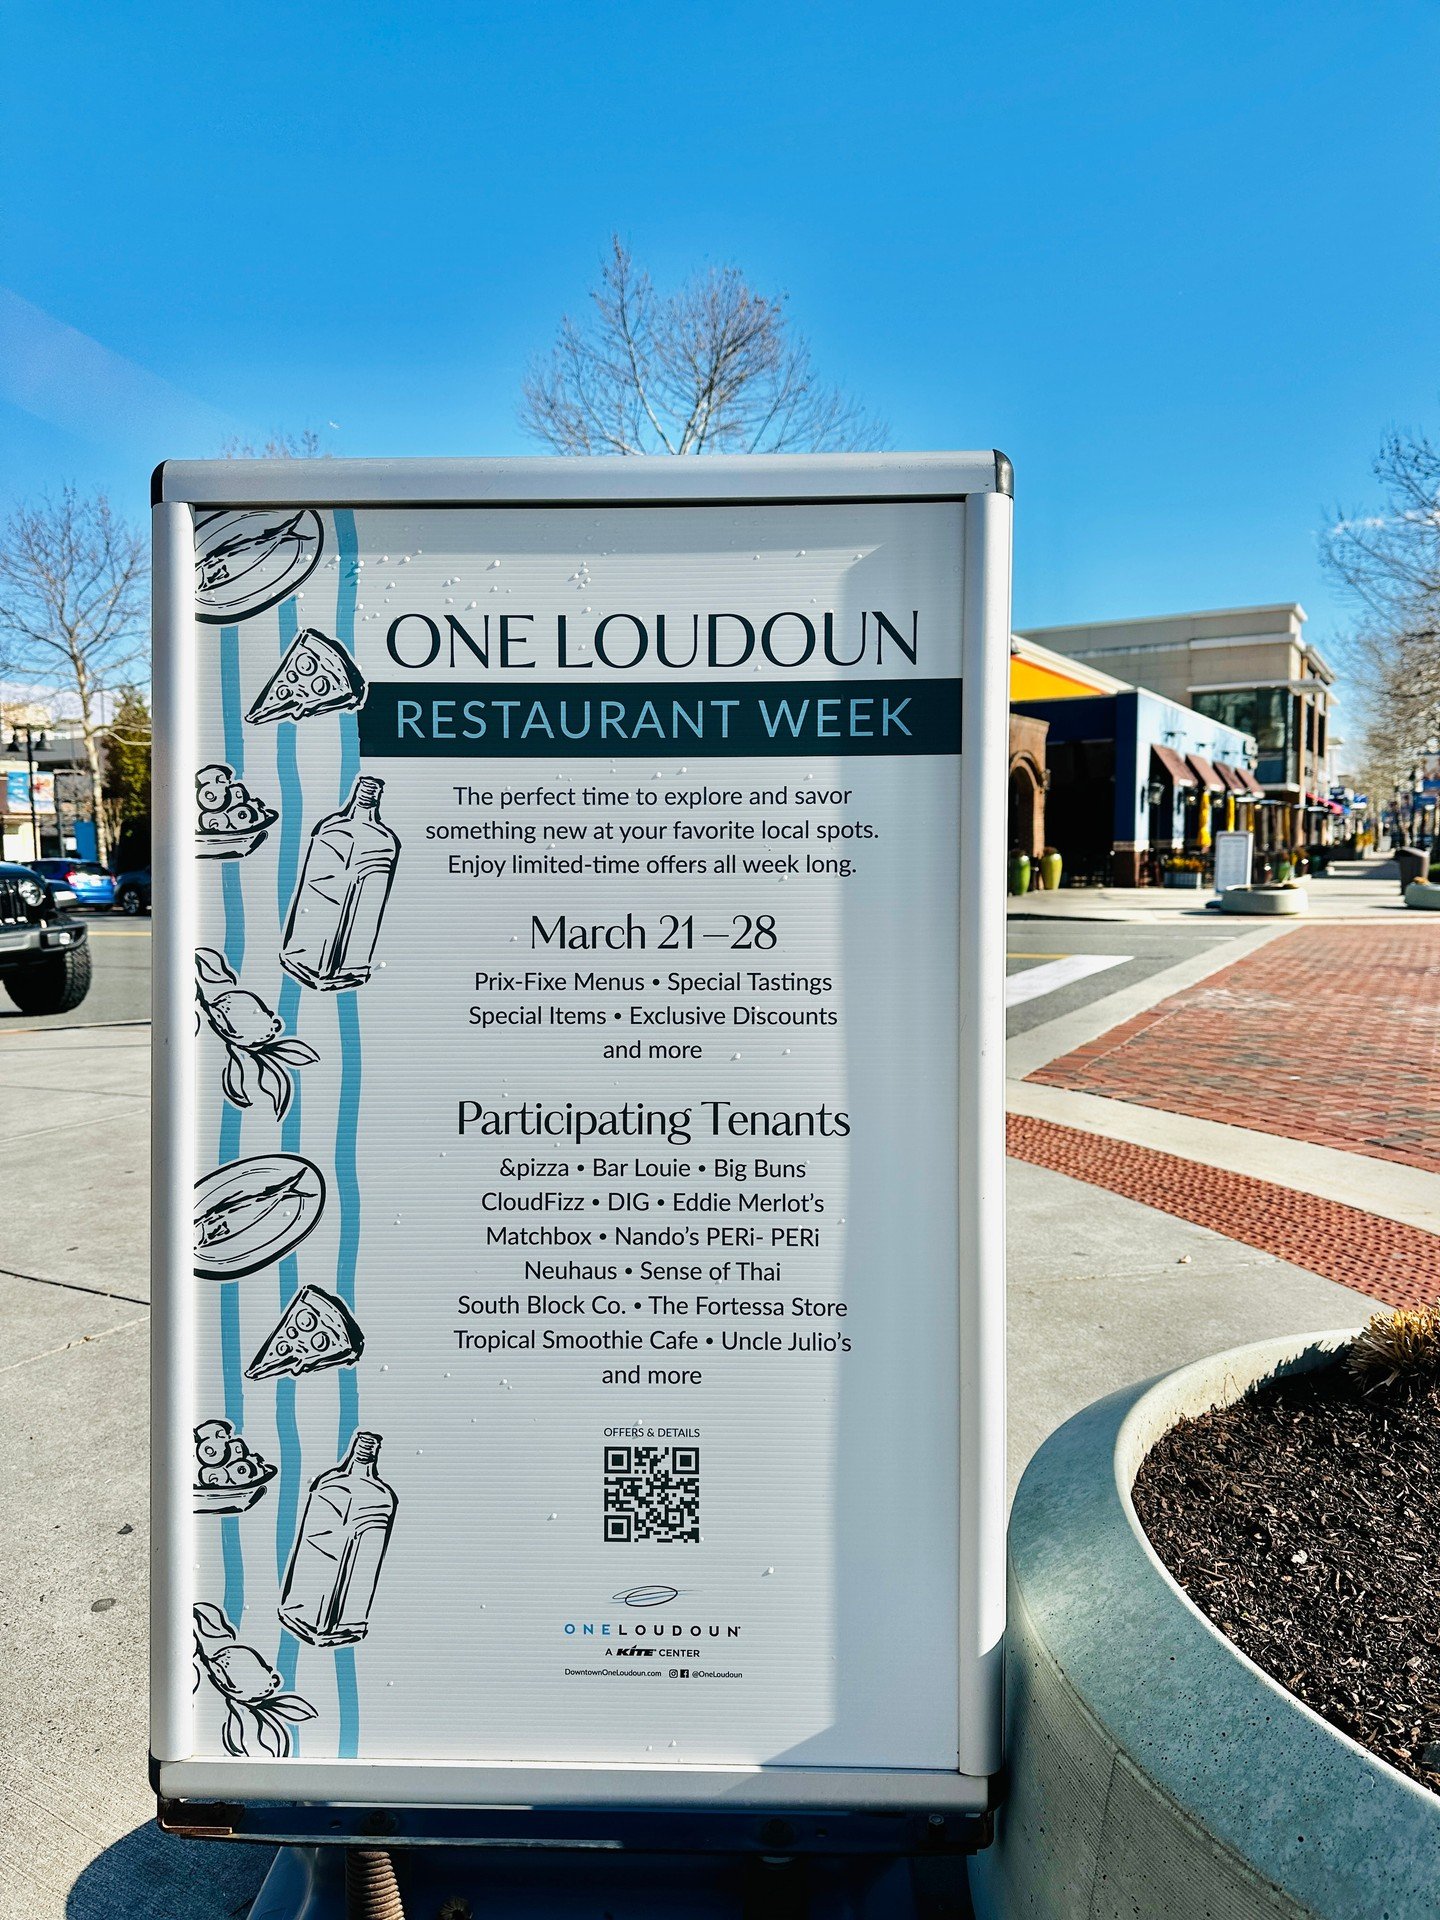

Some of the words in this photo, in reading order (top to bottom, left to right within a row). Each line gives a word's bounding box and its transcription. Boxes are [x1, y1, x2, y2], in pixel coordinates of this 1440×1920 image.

[386, 611, 534, 669] ONE
[558, 611, 918, 668] LOUDOUN
[398, 701, 739, 738] RESTAURANT
[758, 698, 912, 737] WEEK
[453, 787, 493, 805] The
[501, 787, 576, 809] perfect
[582, 787, 629, 805] time
[636, 788, 657, 805] to
[665, 786, 742, 809] explore
[749, 786, 787, 805] and
[795, 791, 852, 804] savor
[426, 821, 536, 843] something
[544, 826, 587, 839] new
[593, 822, 613, 839] at
[619, 826, 667, 843] your
[673, 821, 754, 839] favorite
[762, 820, 808, 839] local
[817, 821, 878, 842] spots.
[449, 855, 506, 878] Enjoy
[513, 855, 639, 873] limited-time
[647, 855, 707, 873] offers
[714, 855, 735, 873] all
[743, 854, 799, 874] week
[807, 854, 856, 877] long.
[532, 913, 645, 949] March
[476, 972, 566, 990] Prix-Fixe
[575, 973, 644, 990] Menus
[668, 972, 740, 995] Special
[747, 972, 832, 995] Tastings
[469, 1006, 541, 1028] Special
[551, 1006, 606, 1024] Items
[631, 1006, 725, 1025] Exclusive
[734, 1006, 837, 1025] Discounts
[603, 1040, 641, 1058] and
[649, 1045, 702, 1058] more
[459, 1101, 692, 1145] Participating
[701, 1102, 850, 1136] Tenants
[500, 1158, 568, 1180] &pizza
[594, 1158, 628, 1177] Bar
[635, 1159, 690, 1177] Louie
[715, 1159, 747, 1181] Big
[755, 1159, 806, 1178] Buns
[482, 1192, 584, 1211] CloudFizz
[609, 1193, 649, 1211] DIG
[674, 1193, 731, 1211] Eddie
[739, 1193, 824, 1212] Merlot’s
[487, 1226, 591, 1245] Matchbox
[616, 1226, 699, 1246] Nando’s
[772, 1228, 819, 1247] PERi
[525, 1261, 617, 1279] Neuhaus
[641, 1261, 702, 1280] Sense
[709, 1262, 731, 1280] of
[735, 1262, 780, 1281] Thai
[458, 1295, 519, 1314] South
[528, 1295, 585, 1314] Block
[592, 1296, 625, 1314] Co.
[648, 1296, 688, 1315] The
[697, 1296, 784, 1316] Fortessa
[792, 1297, 847, 1317] Store
[454, 1330, 535, 1353] Tropical
[543, 1330, 643, 1349] Smoothie
[650, 1331, 698, 1349] Cafe
[722, 1331, 782, 1350] Uncle
[788, 1332, 852, 1352] Julio’s
[602, 1365, 640, 1384] and
[649, 1371, 702, 1384] more
[603, 1427, 644, 1438] OFFERS
[647, 1428, 654, 1437] &
[658, 1428, 700, 1437] DETAILS
[605, 1648, 612, 1656] A
[659, 1649, 700, 1657] CENTER
